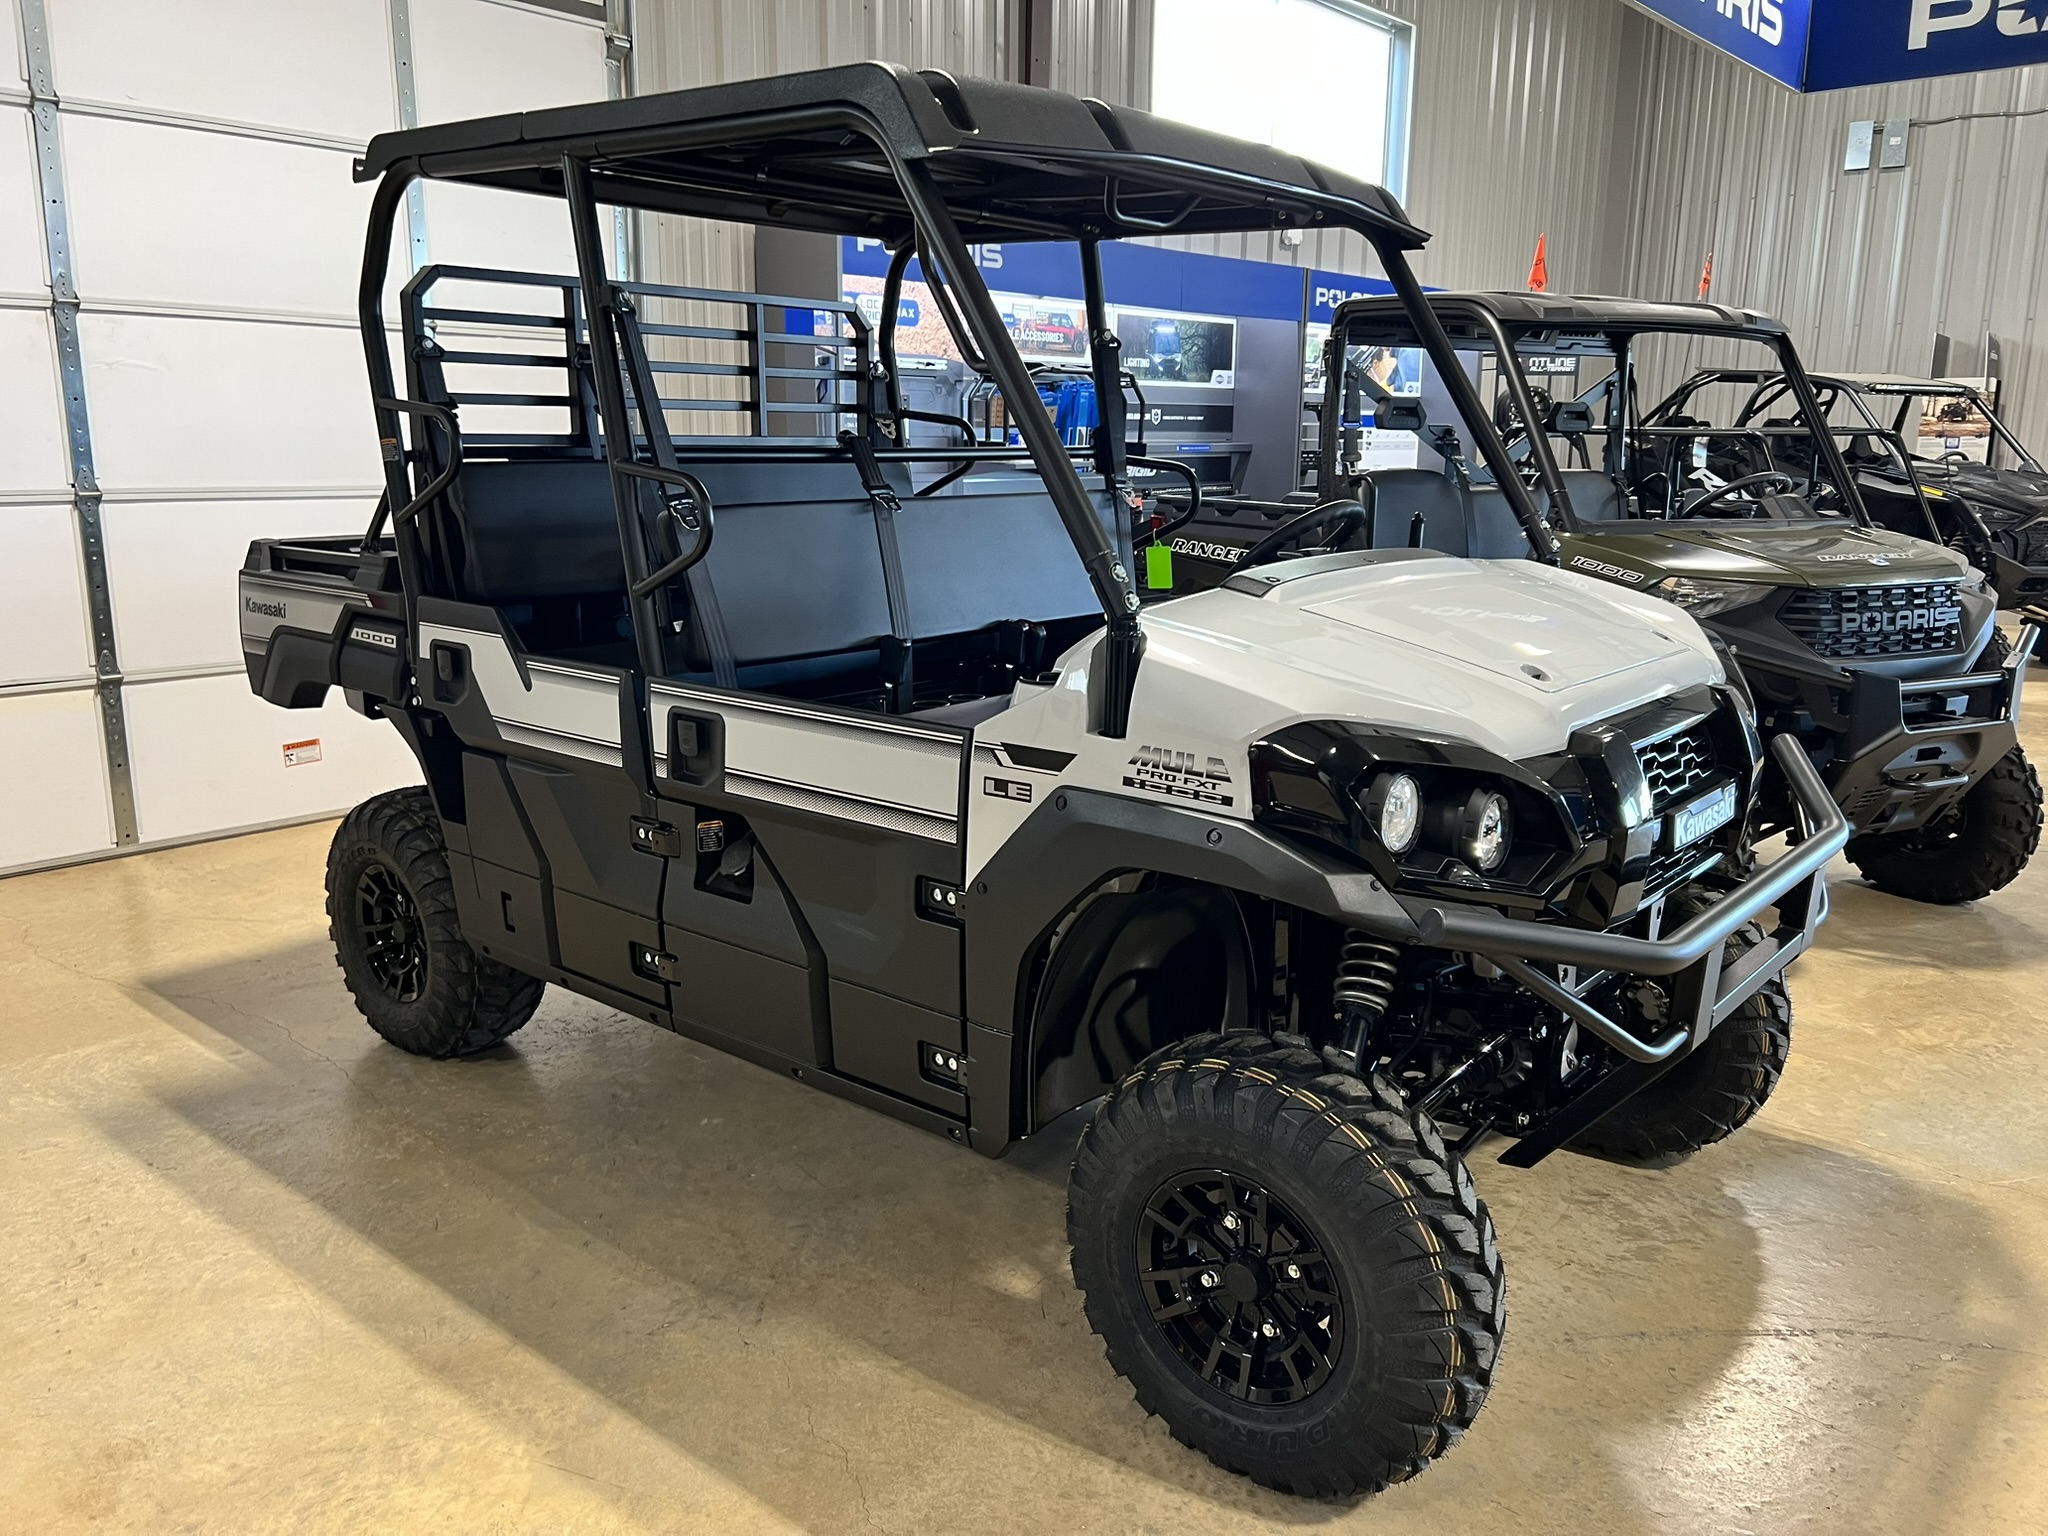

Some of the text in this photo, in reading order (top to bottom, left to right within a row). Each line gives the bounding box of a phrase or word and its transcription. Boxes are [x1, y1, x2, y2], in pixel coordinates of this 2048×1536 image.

[897, 307, 915, 318] AX
[1021, 328, 1064, 343] ACCESSORIES
[1123, 357, 1151, 369] LIGHTING
[1570, 555, 1645, 583] 1000
[245, 596, 287, 619] Kawasaki
[1841, 606, 1950, 634] POLARIS
[355, 630, 395, 645] 1000
[1127, 745, 1233, 784] MULE
[1136, 767, 1222, 791] PRO-FXT
[985, 781, 1031, 801] LE
[1131, 778, 1224, 805] 1000
[1676, 783, 1735, 845] Kawasaki
